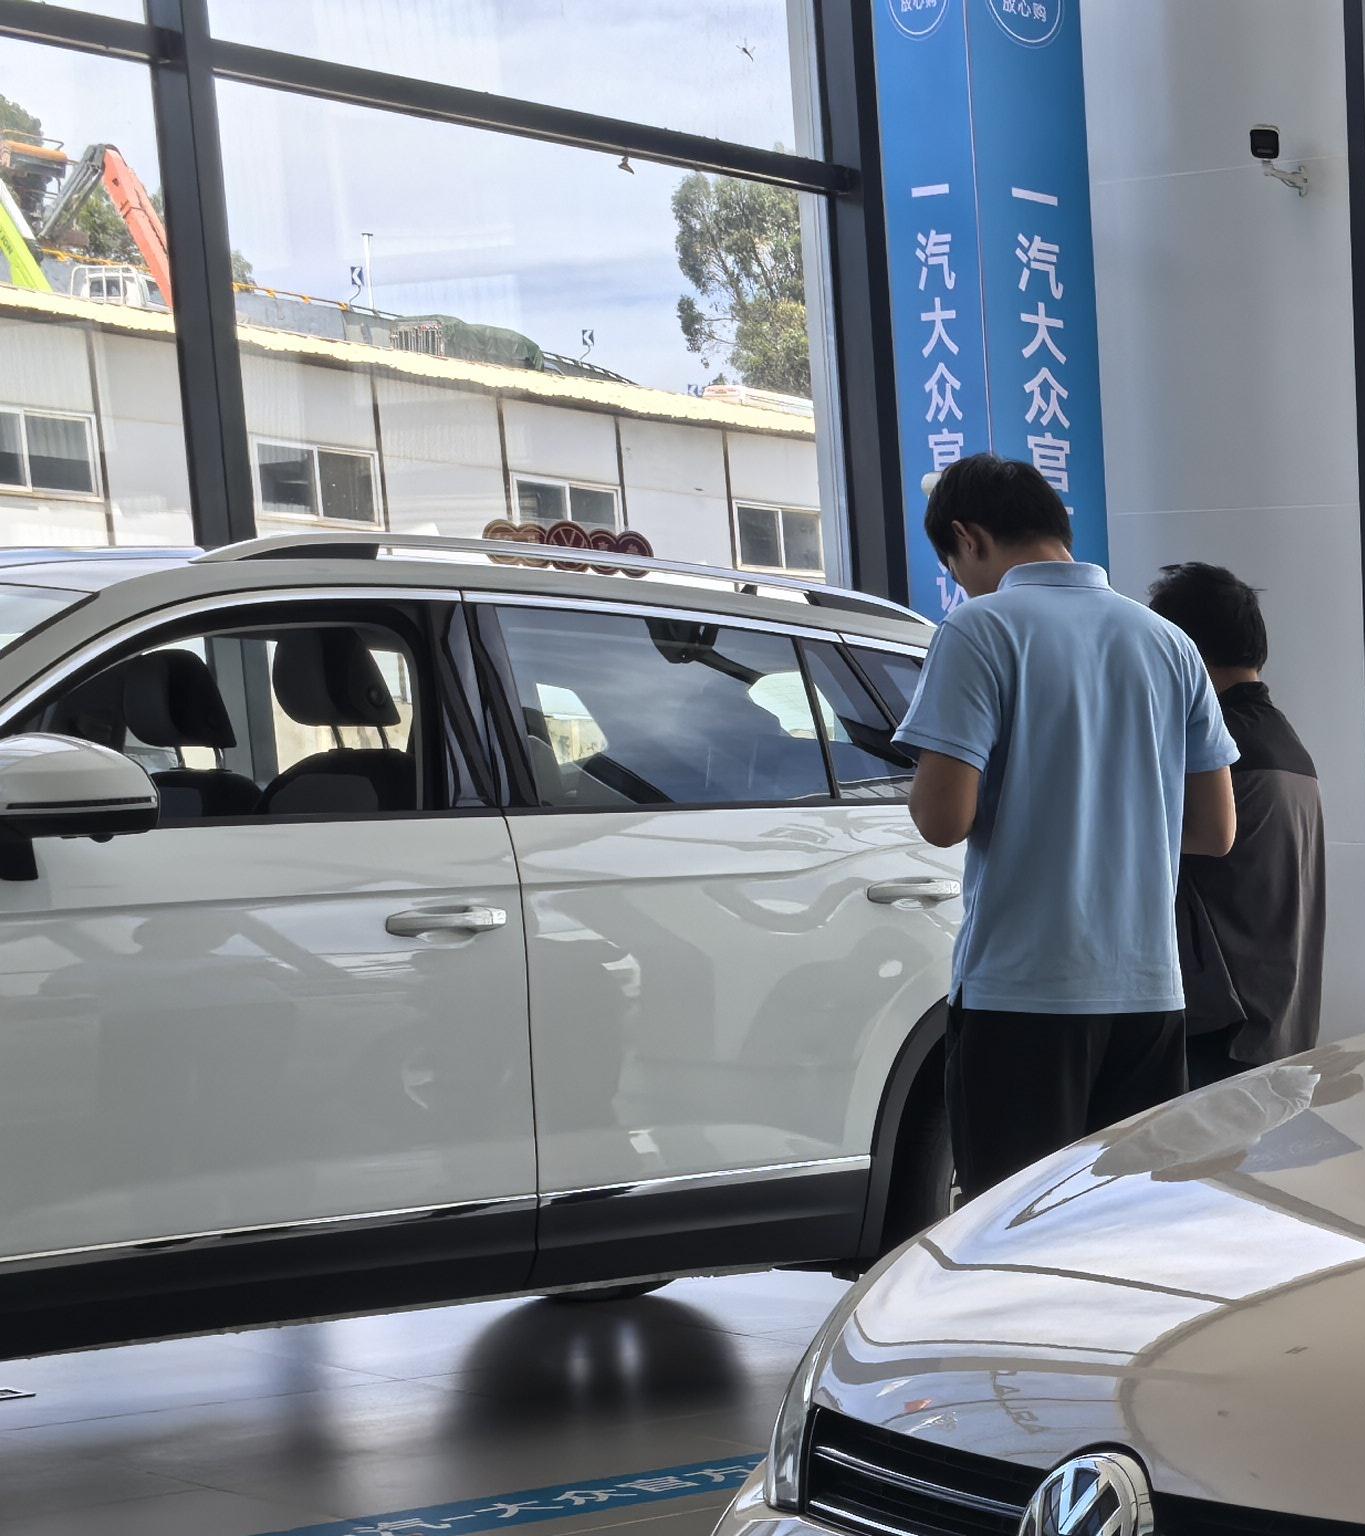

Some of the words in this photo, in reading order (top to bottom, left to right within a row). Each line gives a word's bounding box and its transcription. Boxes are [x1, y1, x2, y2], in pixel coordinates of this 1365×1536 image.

[1011, 187, 1074, 515] 一汽大众官
